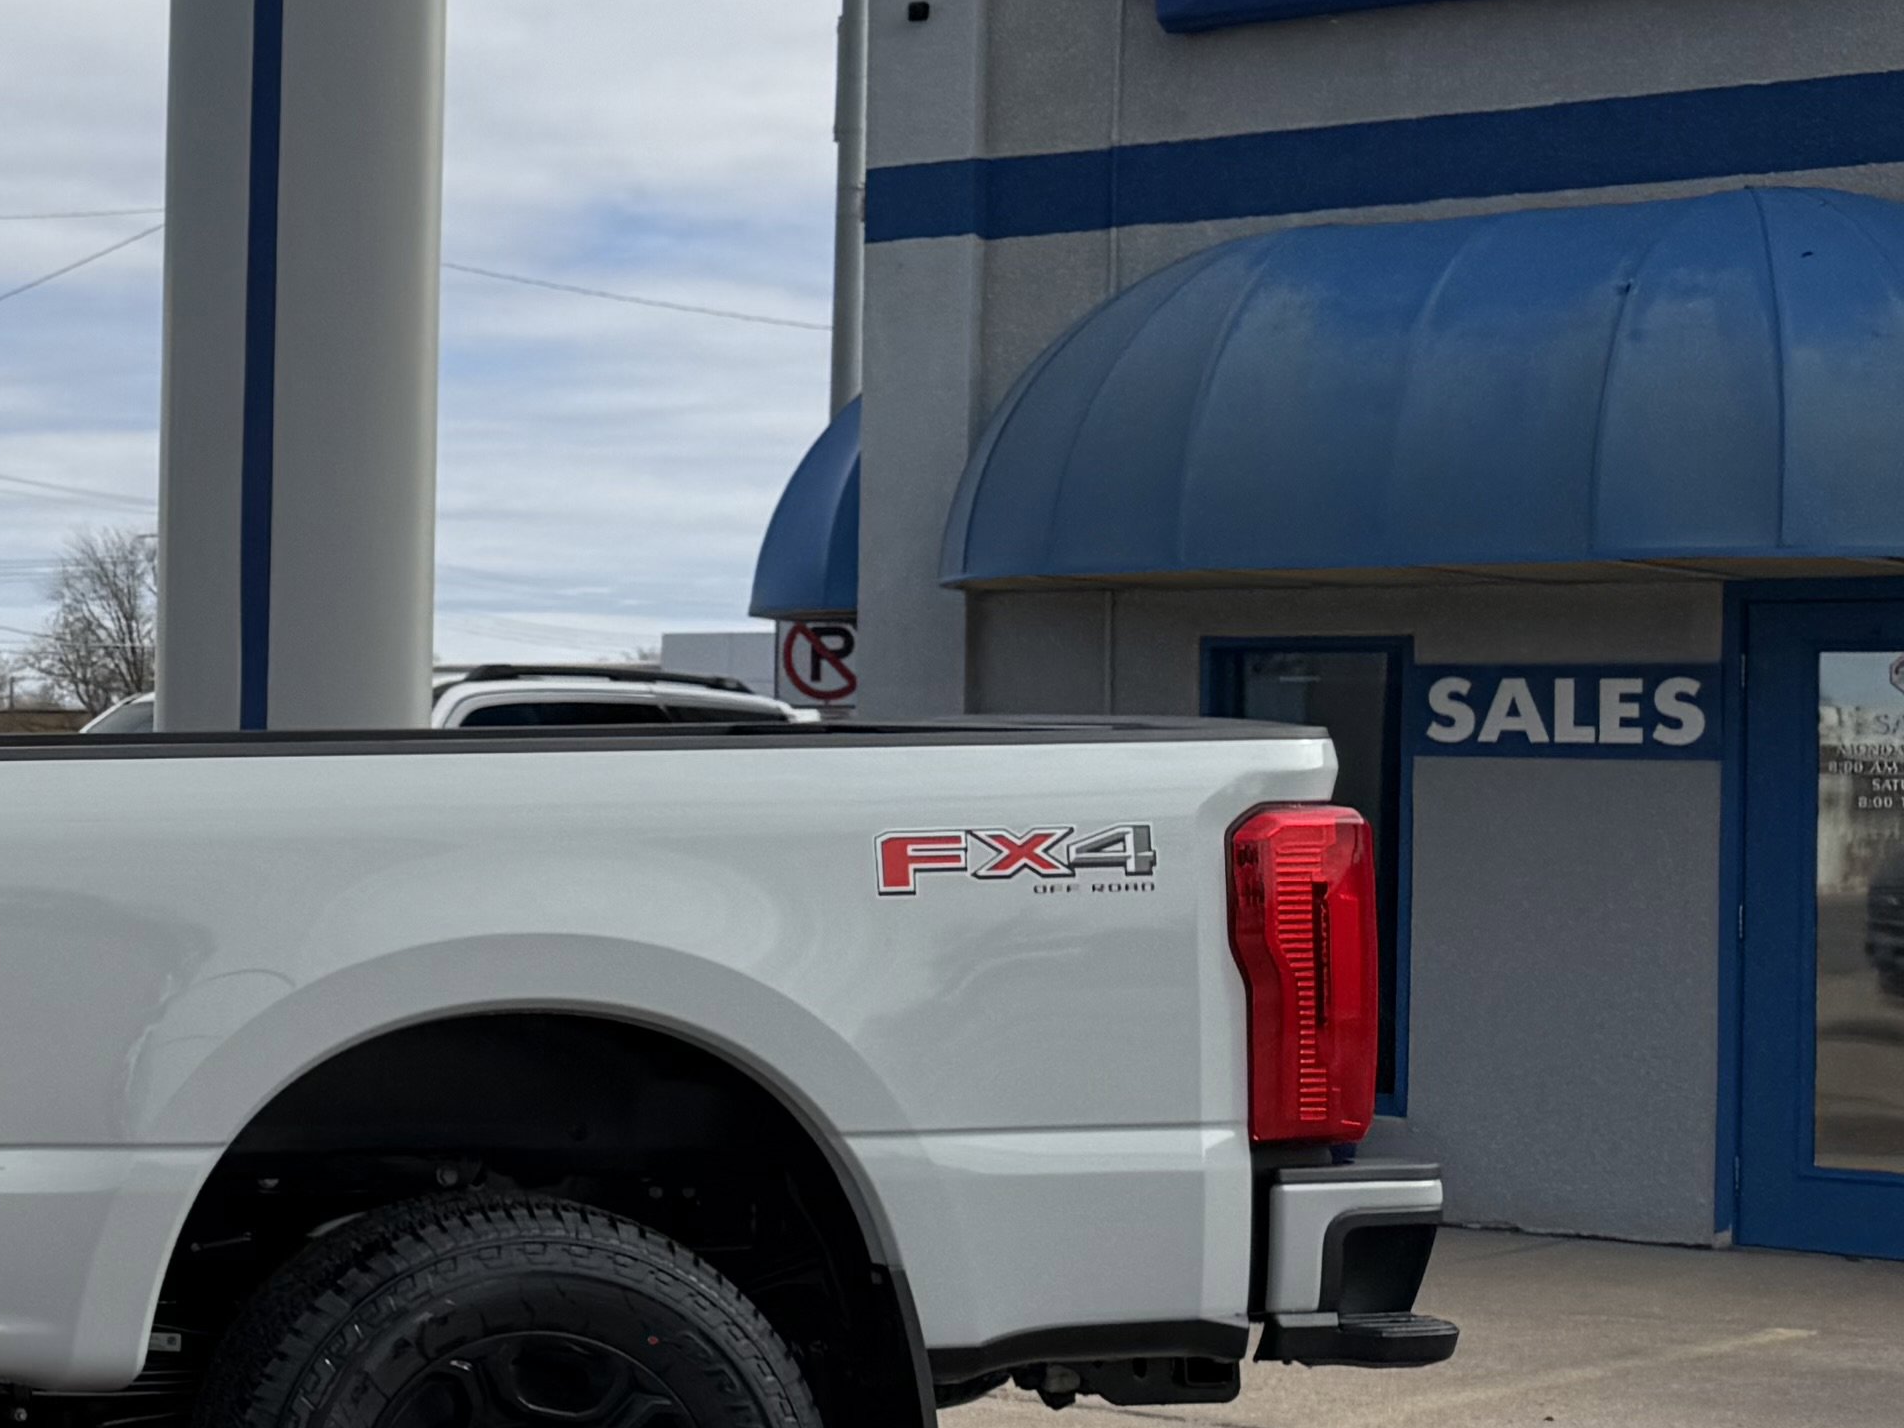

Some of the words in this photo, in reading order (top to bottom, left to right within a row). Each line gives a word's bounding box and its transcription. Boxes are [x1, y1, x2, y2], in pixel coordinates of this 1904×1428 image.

[1426, 676, 1706, 746] SALES
[1857, 795, 1893, 809] 8:00
[875, 824, 1157, 896] FX4
[1033, 882, 1080, 894] OFF
[1092, 881, 1155, 893] ROAD
